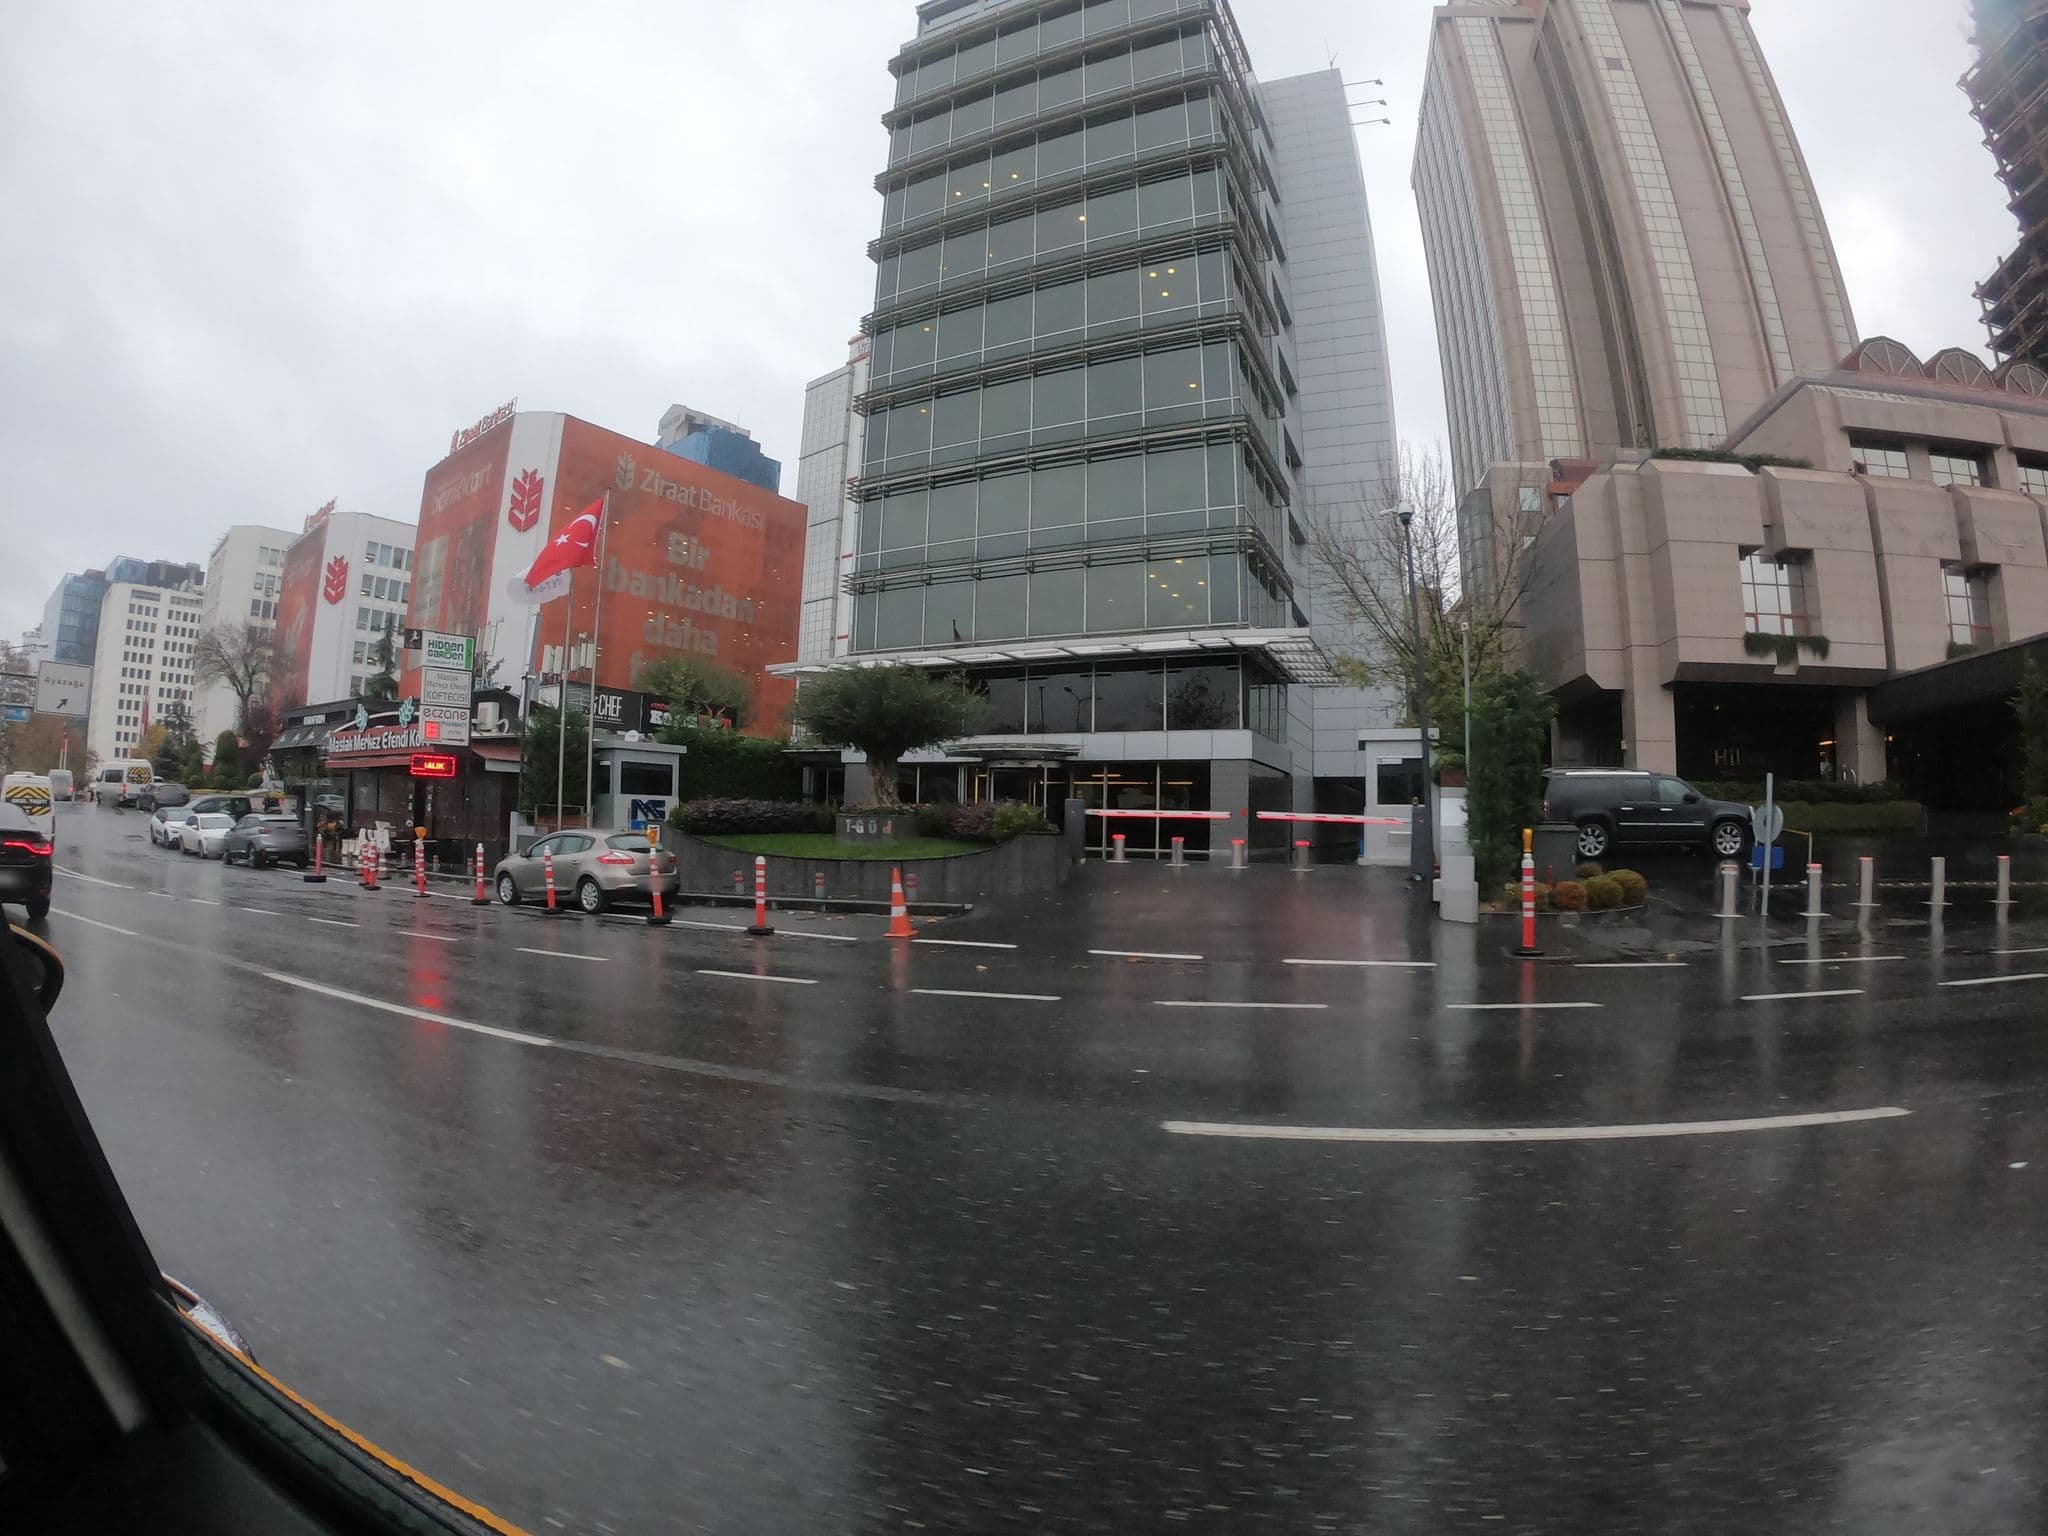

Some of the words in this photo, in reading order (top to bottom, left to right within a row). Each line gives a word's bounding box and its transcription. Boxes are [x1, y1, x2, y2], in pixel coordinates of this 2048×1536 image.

[640, 467, 697, 507] Ziraat
[667, 531, 711, 571] Bir
[607, 554, 756, 625] bankadan
[643, 611, 718, 656] daha
[423, 707, 468, 721] eczane
[599, 694, 623, 717] CHEF
